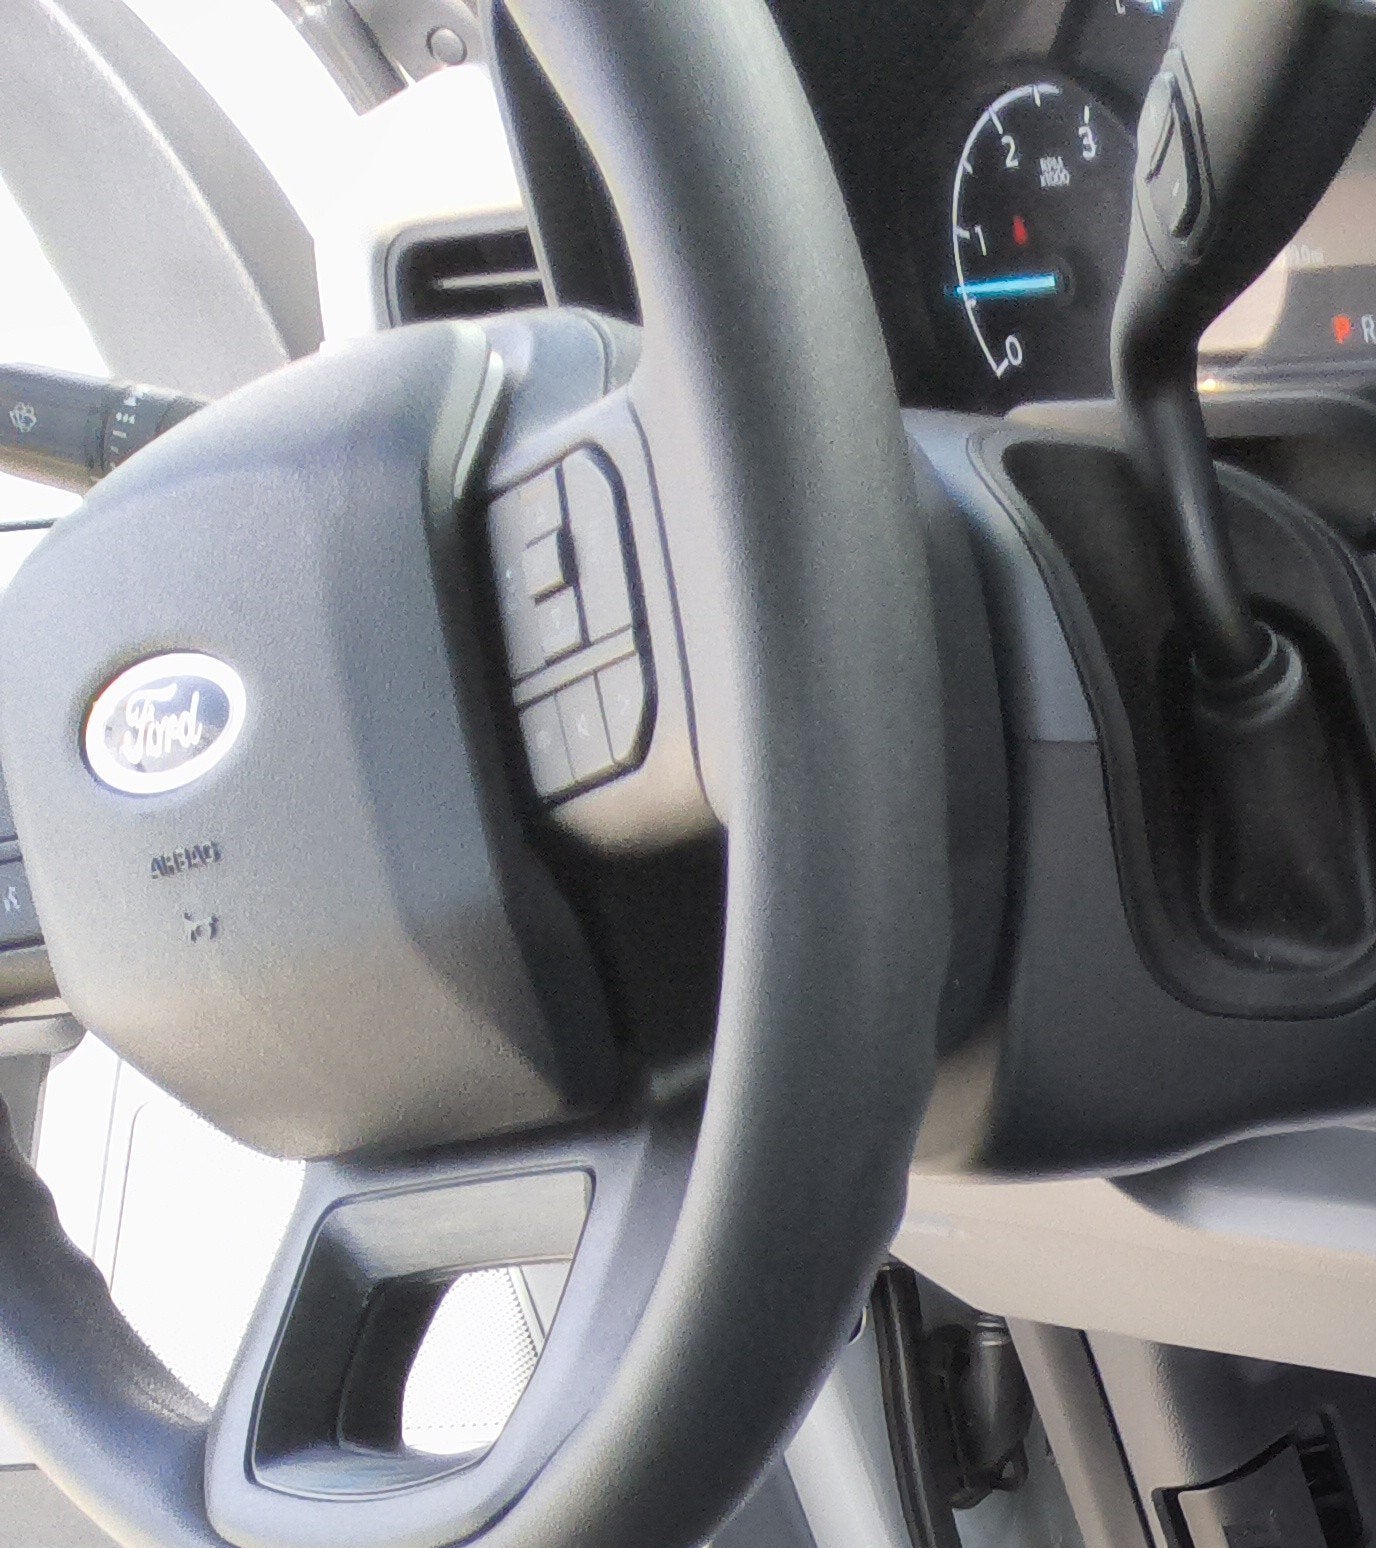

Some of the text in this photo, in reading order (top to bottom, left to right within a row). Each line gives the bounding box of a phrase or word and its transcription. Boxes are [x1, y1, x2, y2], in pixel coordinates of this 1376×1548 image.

[1001, 135, 1018, 168] 2
[1078, 126, 1096, 160] 3
[974, 224, 987, 256] 1
[1333, 314, 1350, 345] P
[1361, 313, 1376, 345] R
[1005, 335, 1023, 366] 0
